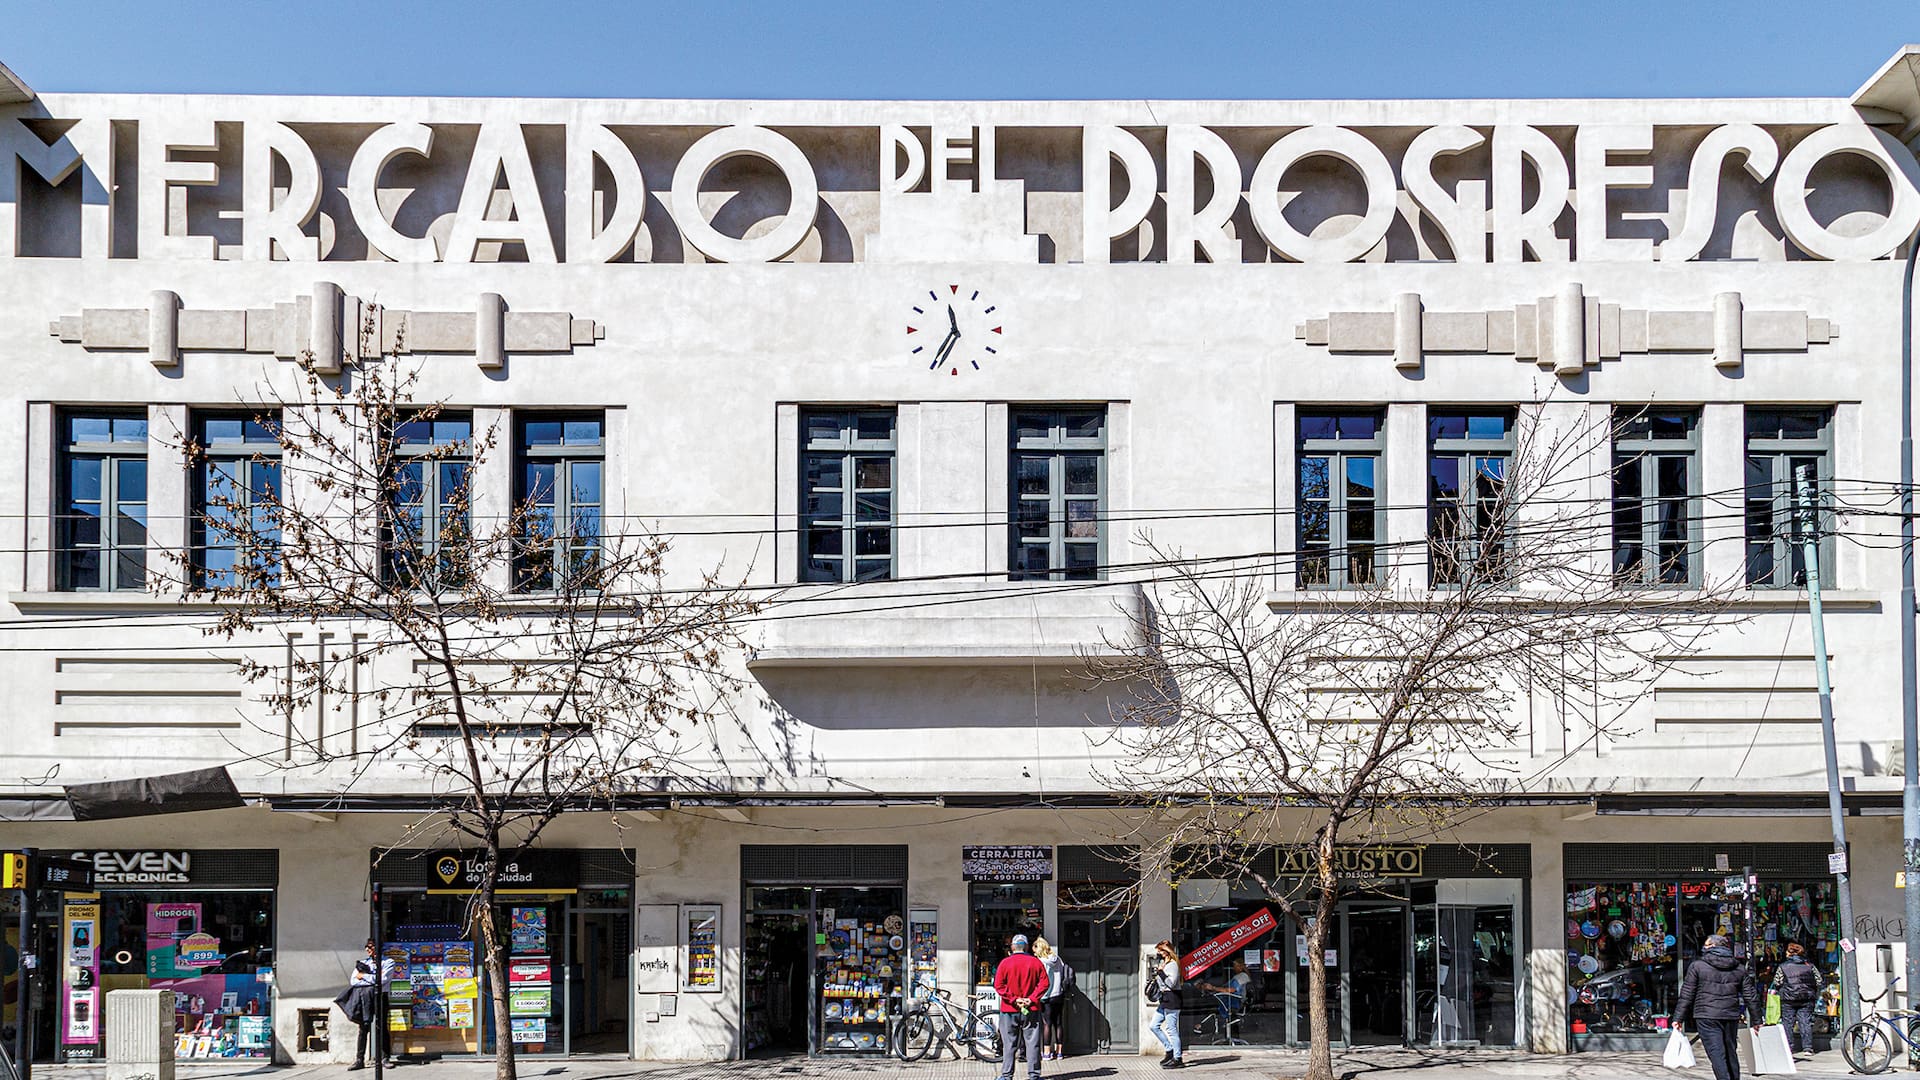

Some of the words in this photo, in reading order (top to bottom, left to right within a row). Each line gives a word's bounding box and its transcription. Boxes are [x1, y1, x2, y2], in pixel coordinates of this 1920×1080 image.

[0, 119, 820, 263] MERCADO
[880, 124, 1025, 194] DEL
[1082, 121, 1920, 263] PROGRESO
[971, 850, 1044, 858] CERRAJERIA
[94, 873, 190, 883] ECTRONICS
[466, 873, 480, 882] de
[155, 909, 197, 917] HIDROGEL
[1230, 924, 1251, 939] 50%
[1251, 914, 1269, 928] OFF
[1193, 941, 1219, 959] PROMO
[193, 951, 213, 960] 899
[74, 969, 89, 981] 12
